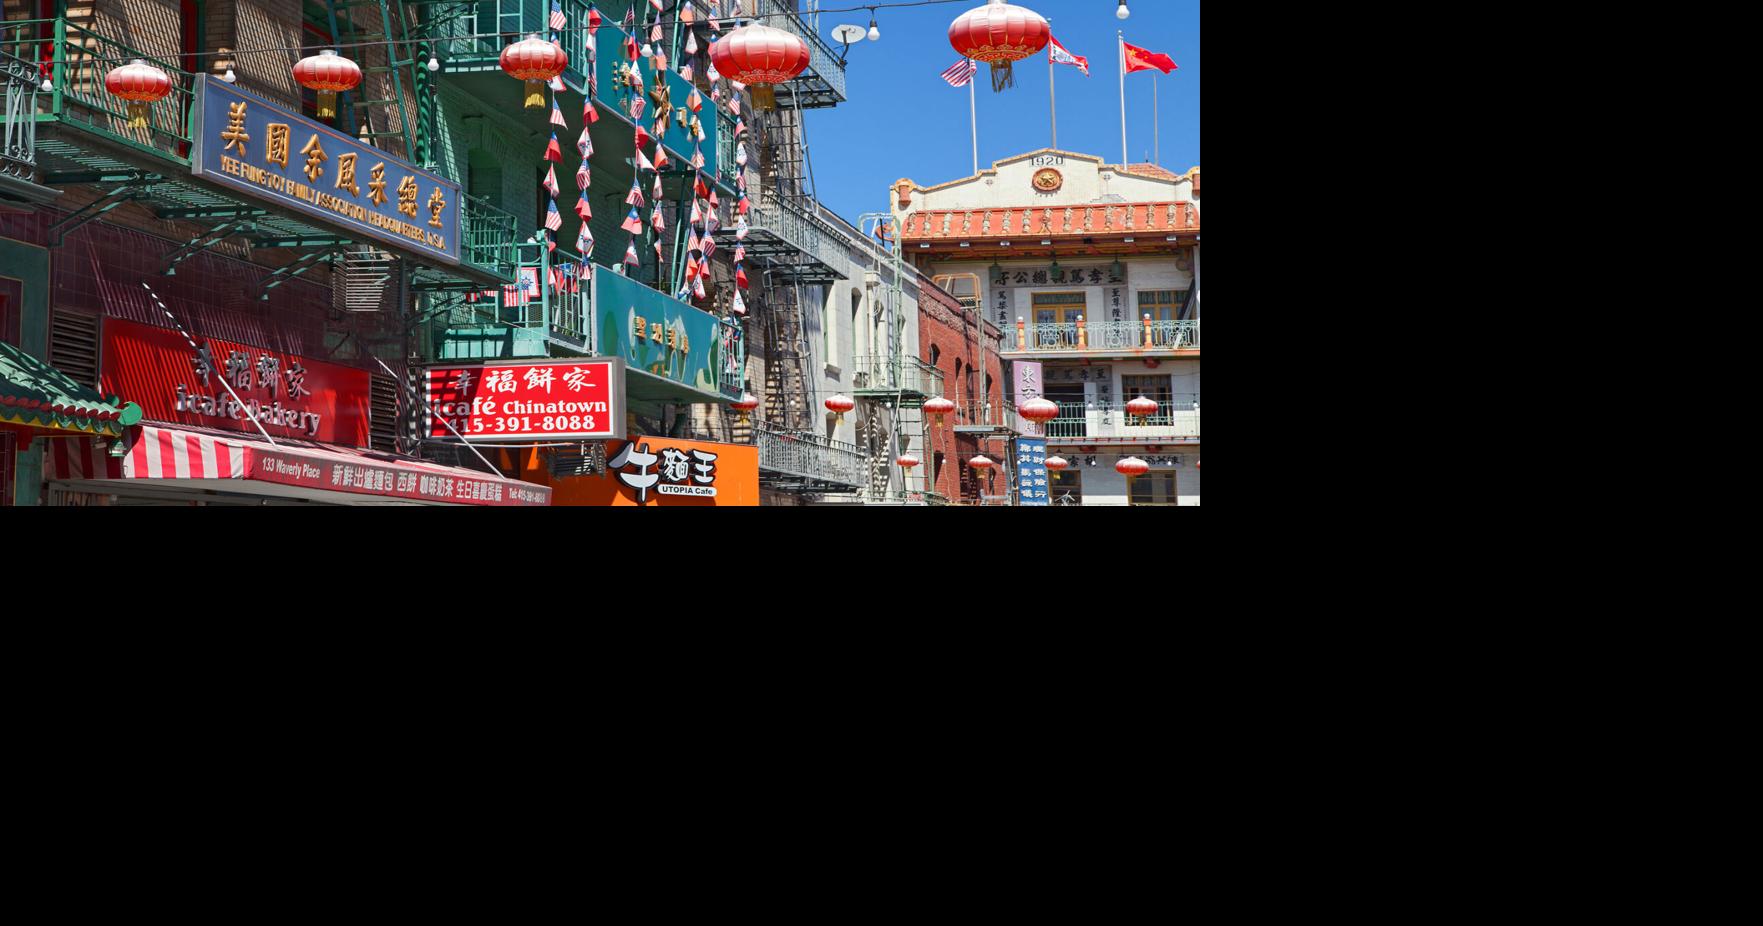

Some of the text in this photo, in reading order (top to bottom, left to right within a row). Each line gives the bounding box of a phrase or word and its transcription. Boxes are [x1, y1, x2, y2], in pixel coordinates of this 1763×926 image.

[1030, 155, 1064, 166] 1920
[220, 154, 240, 176] YEE
[240, 162, 267, 185] FUNG
[266, 171, 285, 192] TOY
[285, 179, 316, 202] FAMILY
[315, 191, 367, 222] ASSOCIATION
[449, 366, 597, 396] 幸福餅家
[433, 396, 607, 417] icafé Chinatown
[446, 415, 595, 433] 415-391-8088
[262, 457, 320, 479] 133 Waverly Place
[397, 472, 418, 493] 西餅
[419, 475, 454, 497] 咖啡奶茶
[662, 486, 713, 495] UTOPIA Cafe
